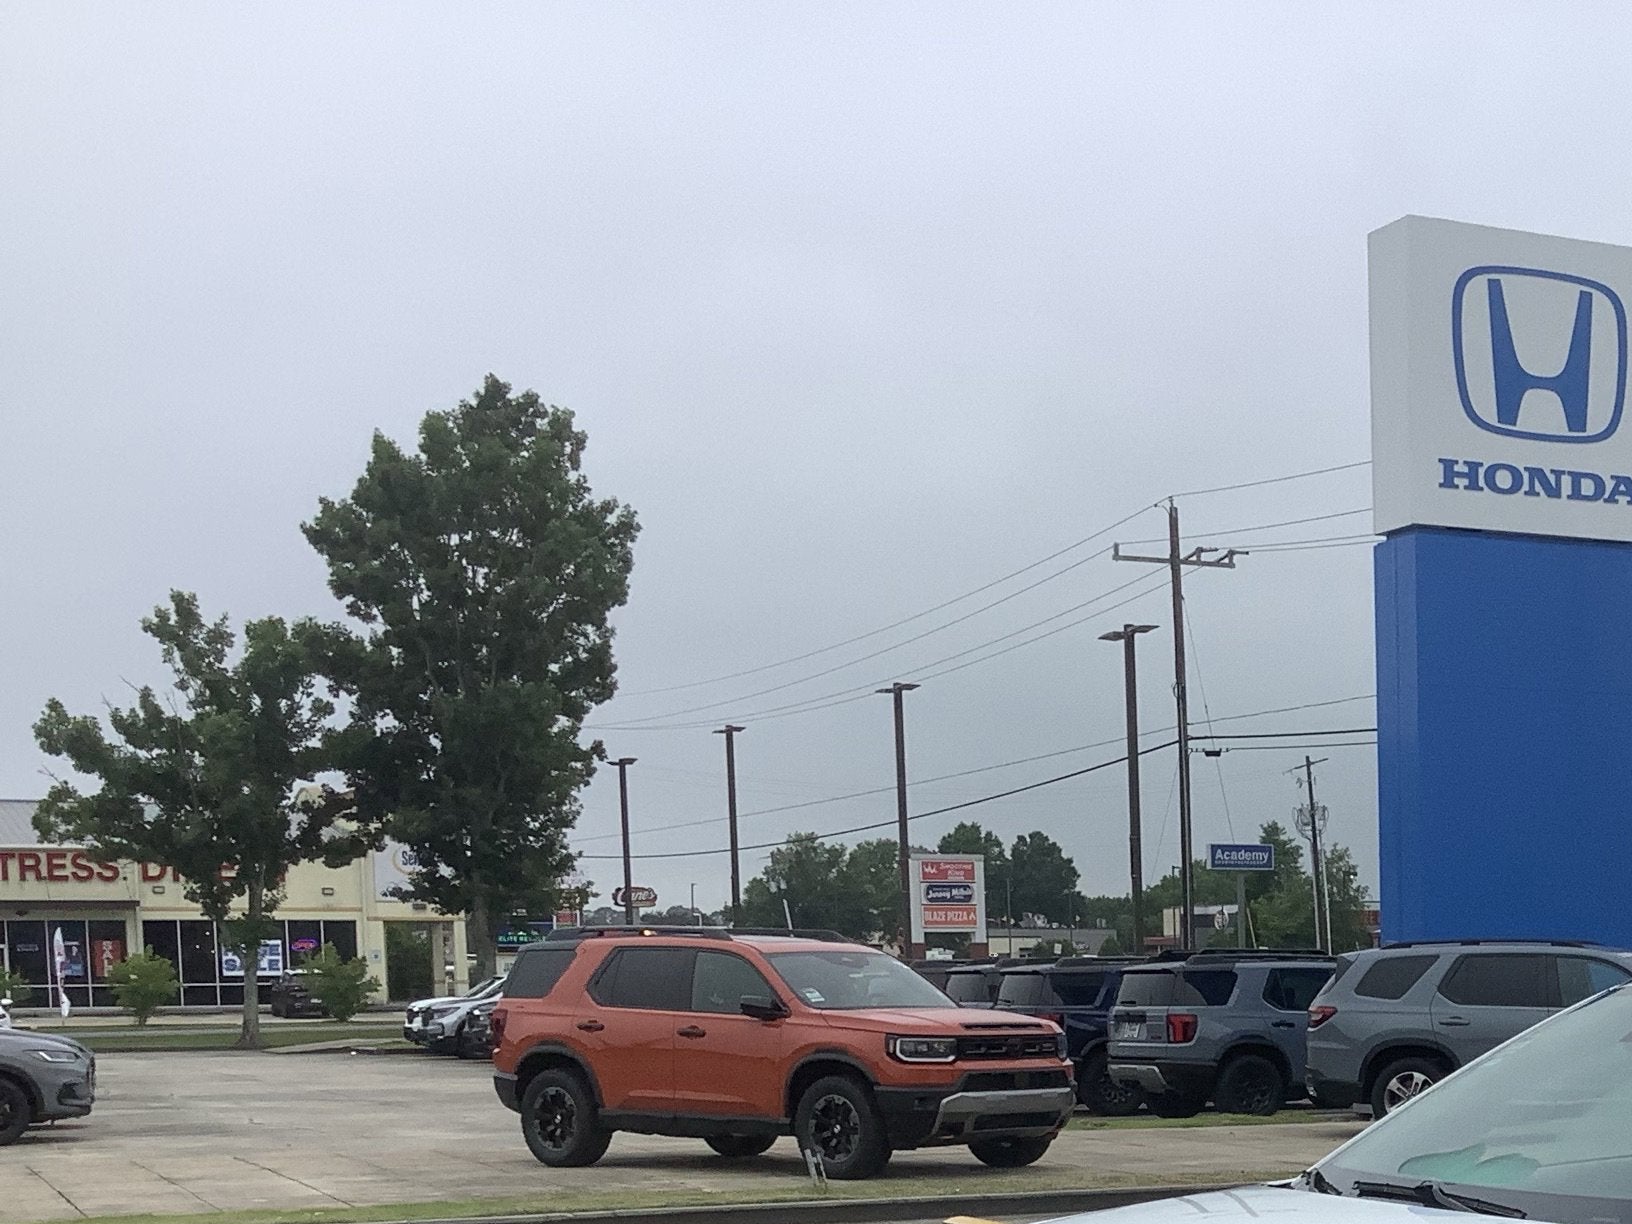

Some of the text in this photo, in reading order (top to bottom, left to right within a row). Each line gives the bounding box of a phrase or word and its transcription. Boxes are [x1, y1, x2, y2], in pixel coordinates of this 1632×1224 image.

[1215, 849, 1269, 863] Academy
[947, 911, 968, 921] PIZZA
[224, 958, 281, 971] SLE
